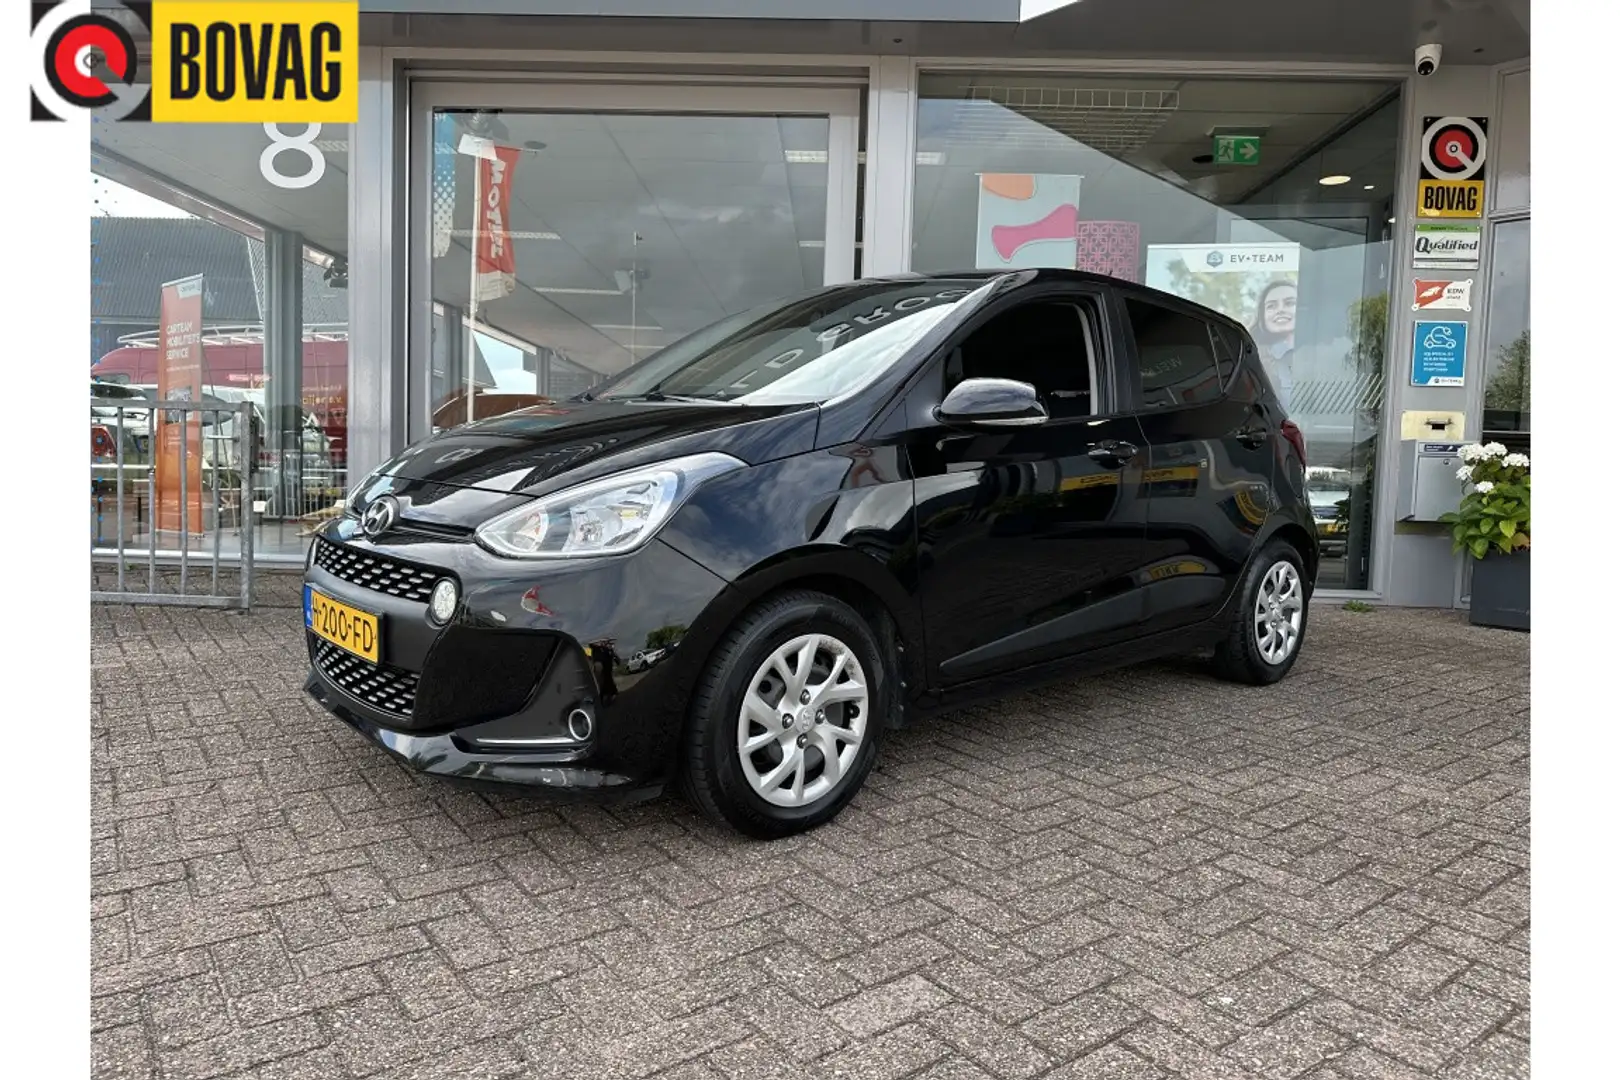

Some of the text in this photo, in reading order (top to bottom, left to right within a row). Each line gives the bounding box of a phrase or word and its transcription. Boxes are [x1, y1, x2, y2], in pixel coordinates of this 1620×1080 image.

[1424, 185, 1478, 211] BOVAG
[1415, 237, 1478, 254] Qualified
[313, 595, 373, 653] H-200-FD
